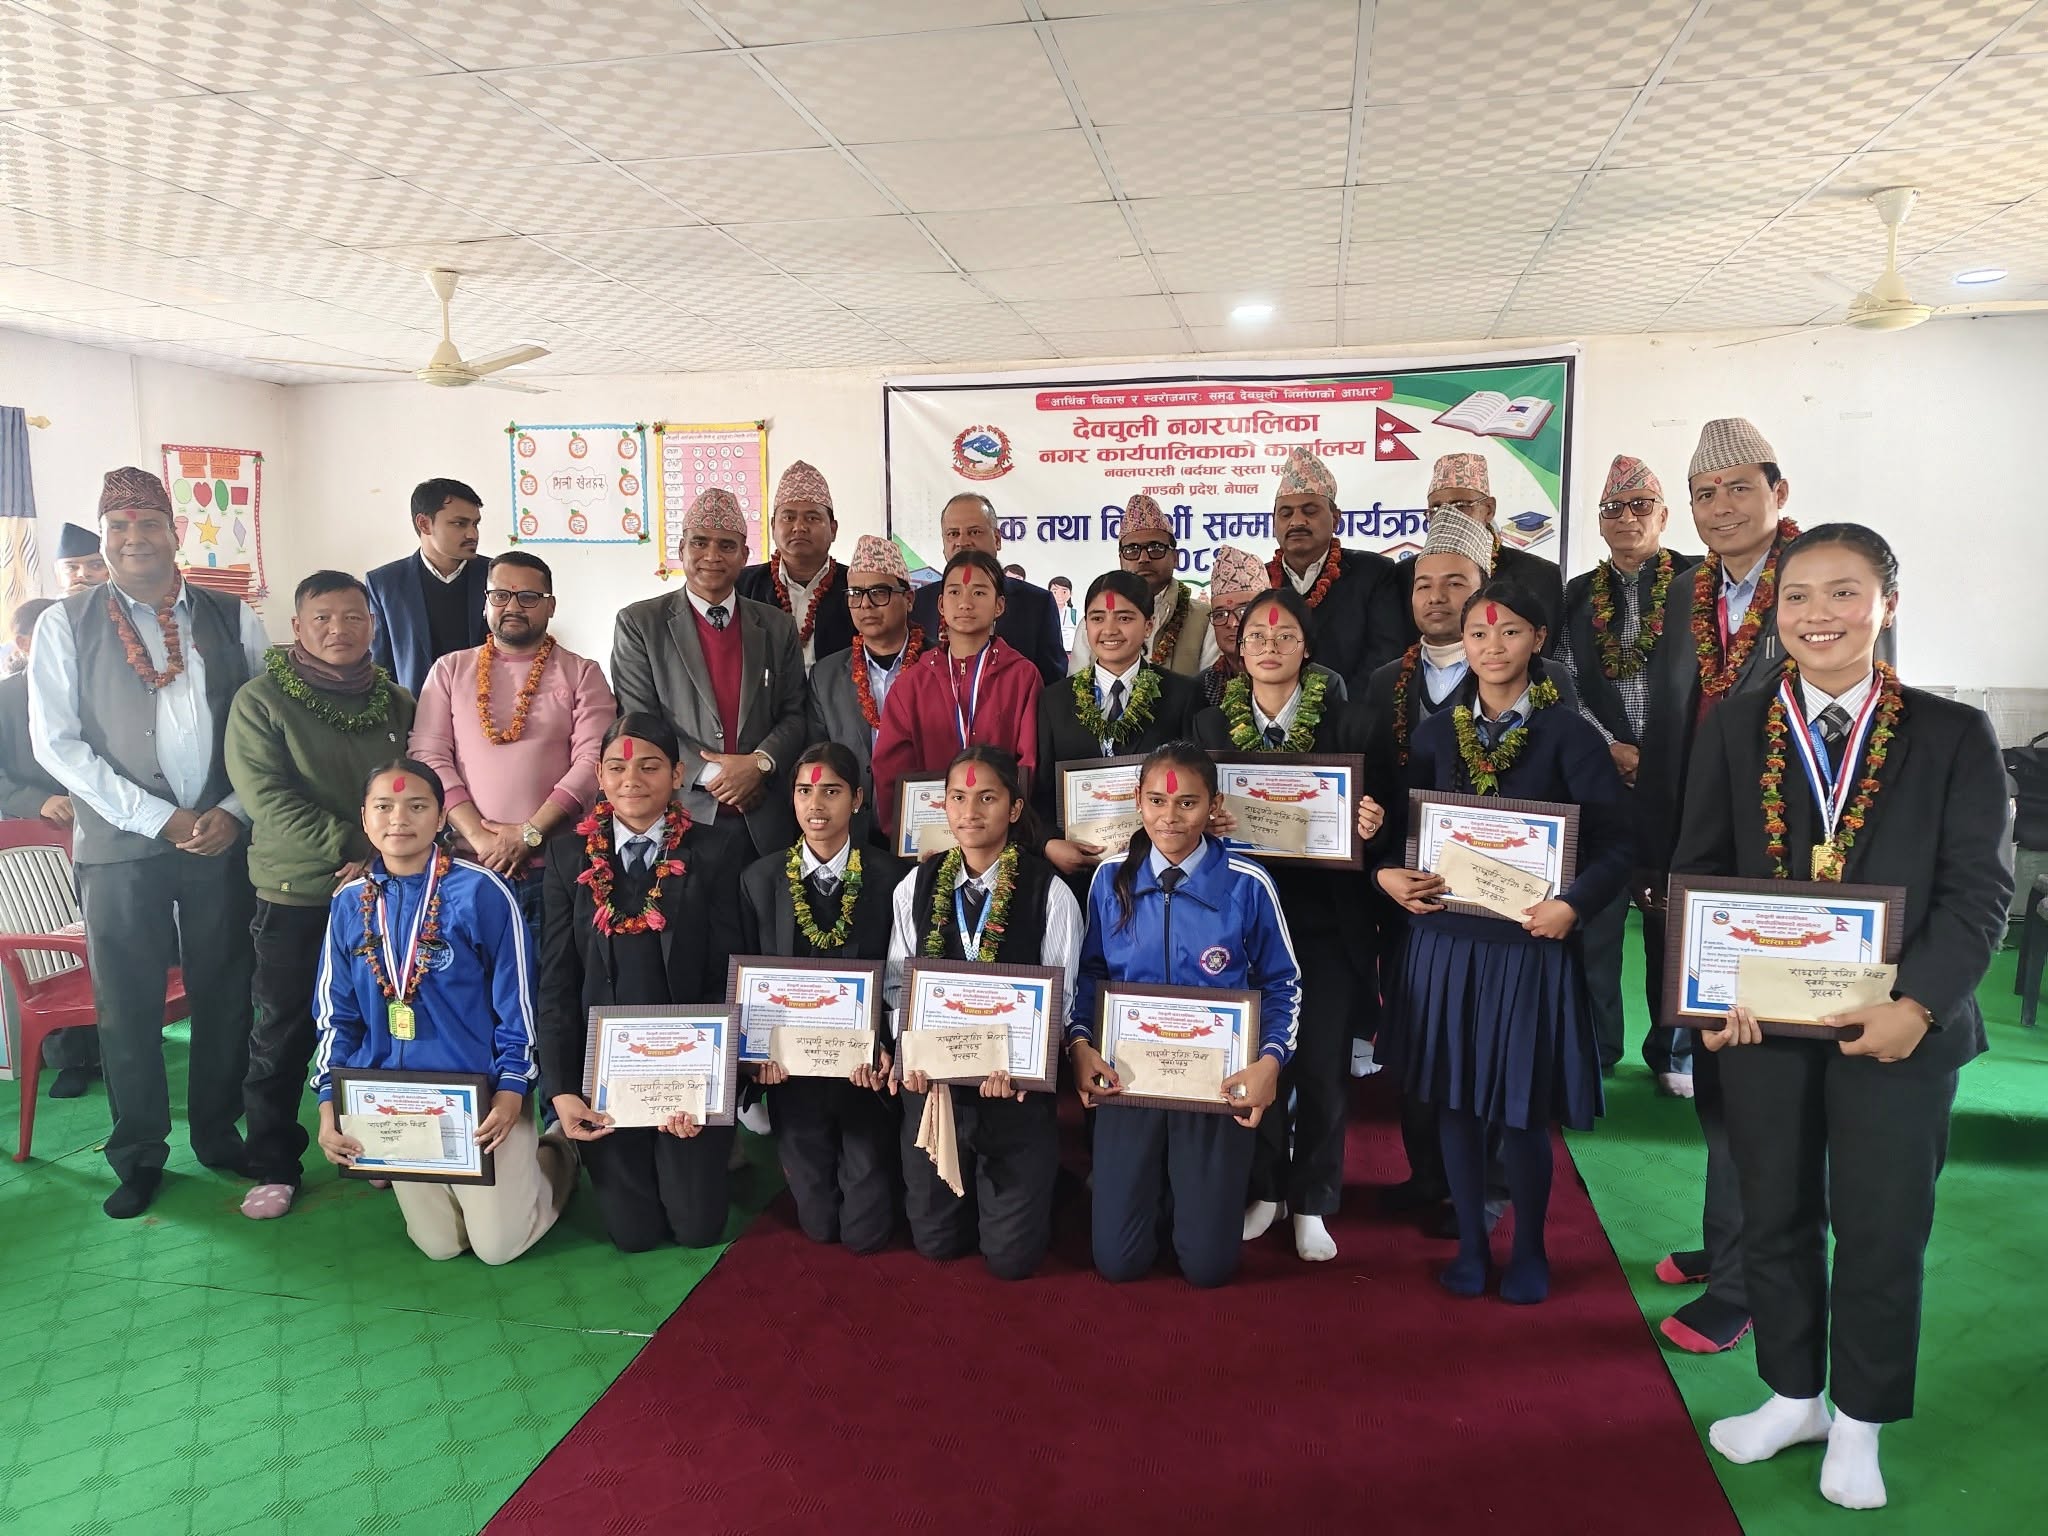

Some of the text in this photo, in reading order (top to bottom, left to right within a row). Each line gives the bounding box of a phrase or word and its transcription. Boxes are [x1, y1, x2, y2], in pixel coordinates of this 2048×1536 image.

[1091, 394, 1125, 406] विकास
[1131, 395, 1139, 405] र
[1284, 386, 1335, 399] निर्माणको
[1073, 410, 1320, 442] देवचुली नगरपालिका
[1039, 449, 1090, 463] नगर
[1097, 439, 1256, 463] कार्यपालिकाको
[1104, 465, 1175, 478] नवलपरासी
[1232, 464, 1265, 477] सुस्ता
[1142, 483, 1185, 496] गण्डकी
[1225, 481, 1259, 494] नेपाल
[1037, 515, 1091, 543] तथा
